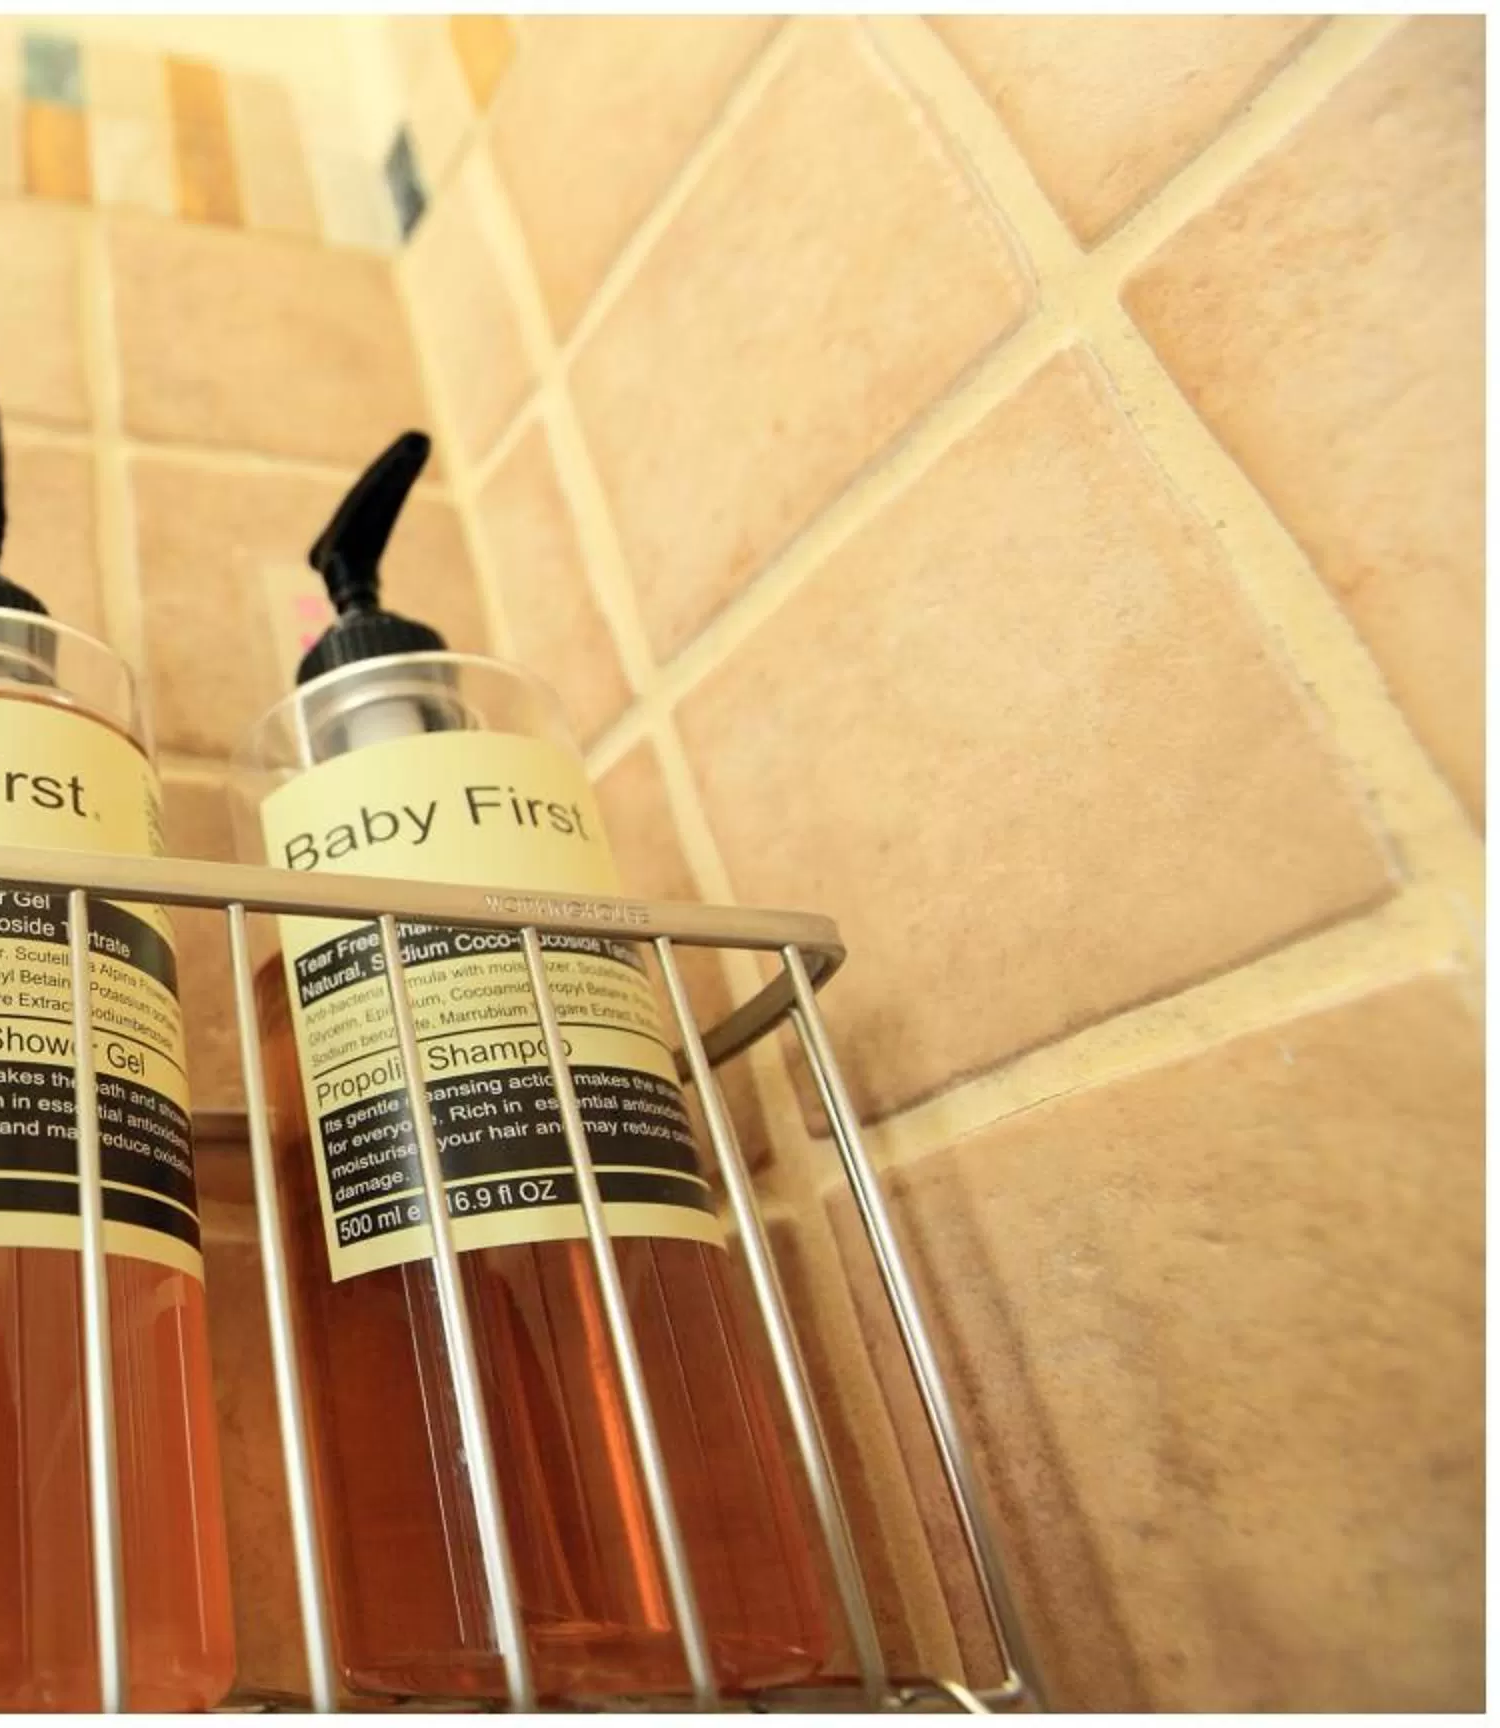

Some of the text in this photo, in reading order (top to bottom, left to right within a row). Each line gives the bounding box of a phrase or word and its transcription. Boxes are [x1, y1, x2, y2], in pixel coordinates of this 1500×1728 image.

[284, 800, 438, 871] Baby
[13, 890, 51, 909] Gel
[61, 921, 132, 958] Trtrate
[297, 932, 380, 977] Tear Free
[371, 940, 449, 971] Sdium
[19, 969, 72, 990] Betain
[19, 992, 72, 1013] Extrac
[107, 1042, 145, 1077] Gel
[51, 1071, 76, 1089] th
[130, 1090, 156, 1111] and
[316, 1057, 403, 1111] Propoli
[12, 1092, 31, 1111] in
[38, 1100, 123, 1124] esstial
[325, 1118, 343, 1135] Its
[346, 1097, 399, 1129] gentle
[405, 1075, 502, 1107] eansing
[509, 1071, 555, 1090] actio
[574, 1071, 631, 1089] makes
[0, 1119, 40, 1137] and
[47, 1123, 81, 1141] ma
[327, 1139, 349, 1157] for
[449, 1100, 498, 1123] Rich
[503, 1099, 523, 1115] in
[535, 1094, 619, 1112] esntial
[330, 1142, 419, 1181] moisturise
[435, 1129, 483, 1153] your
[489, 1121, 530, 1141] hair
[535, 1121, 563, 1136] an
[582, 1120, 618, 1137] may
[335, 1170, 411, 1204] damage.
[339, 1214, 373, 1242] 500
[378, 1204, 402, 1230] ml
[407, 1204, 421, 1221] e
[498, 1184, 513, 1205] fl
[519, 1179, 557, 1203] OZ
